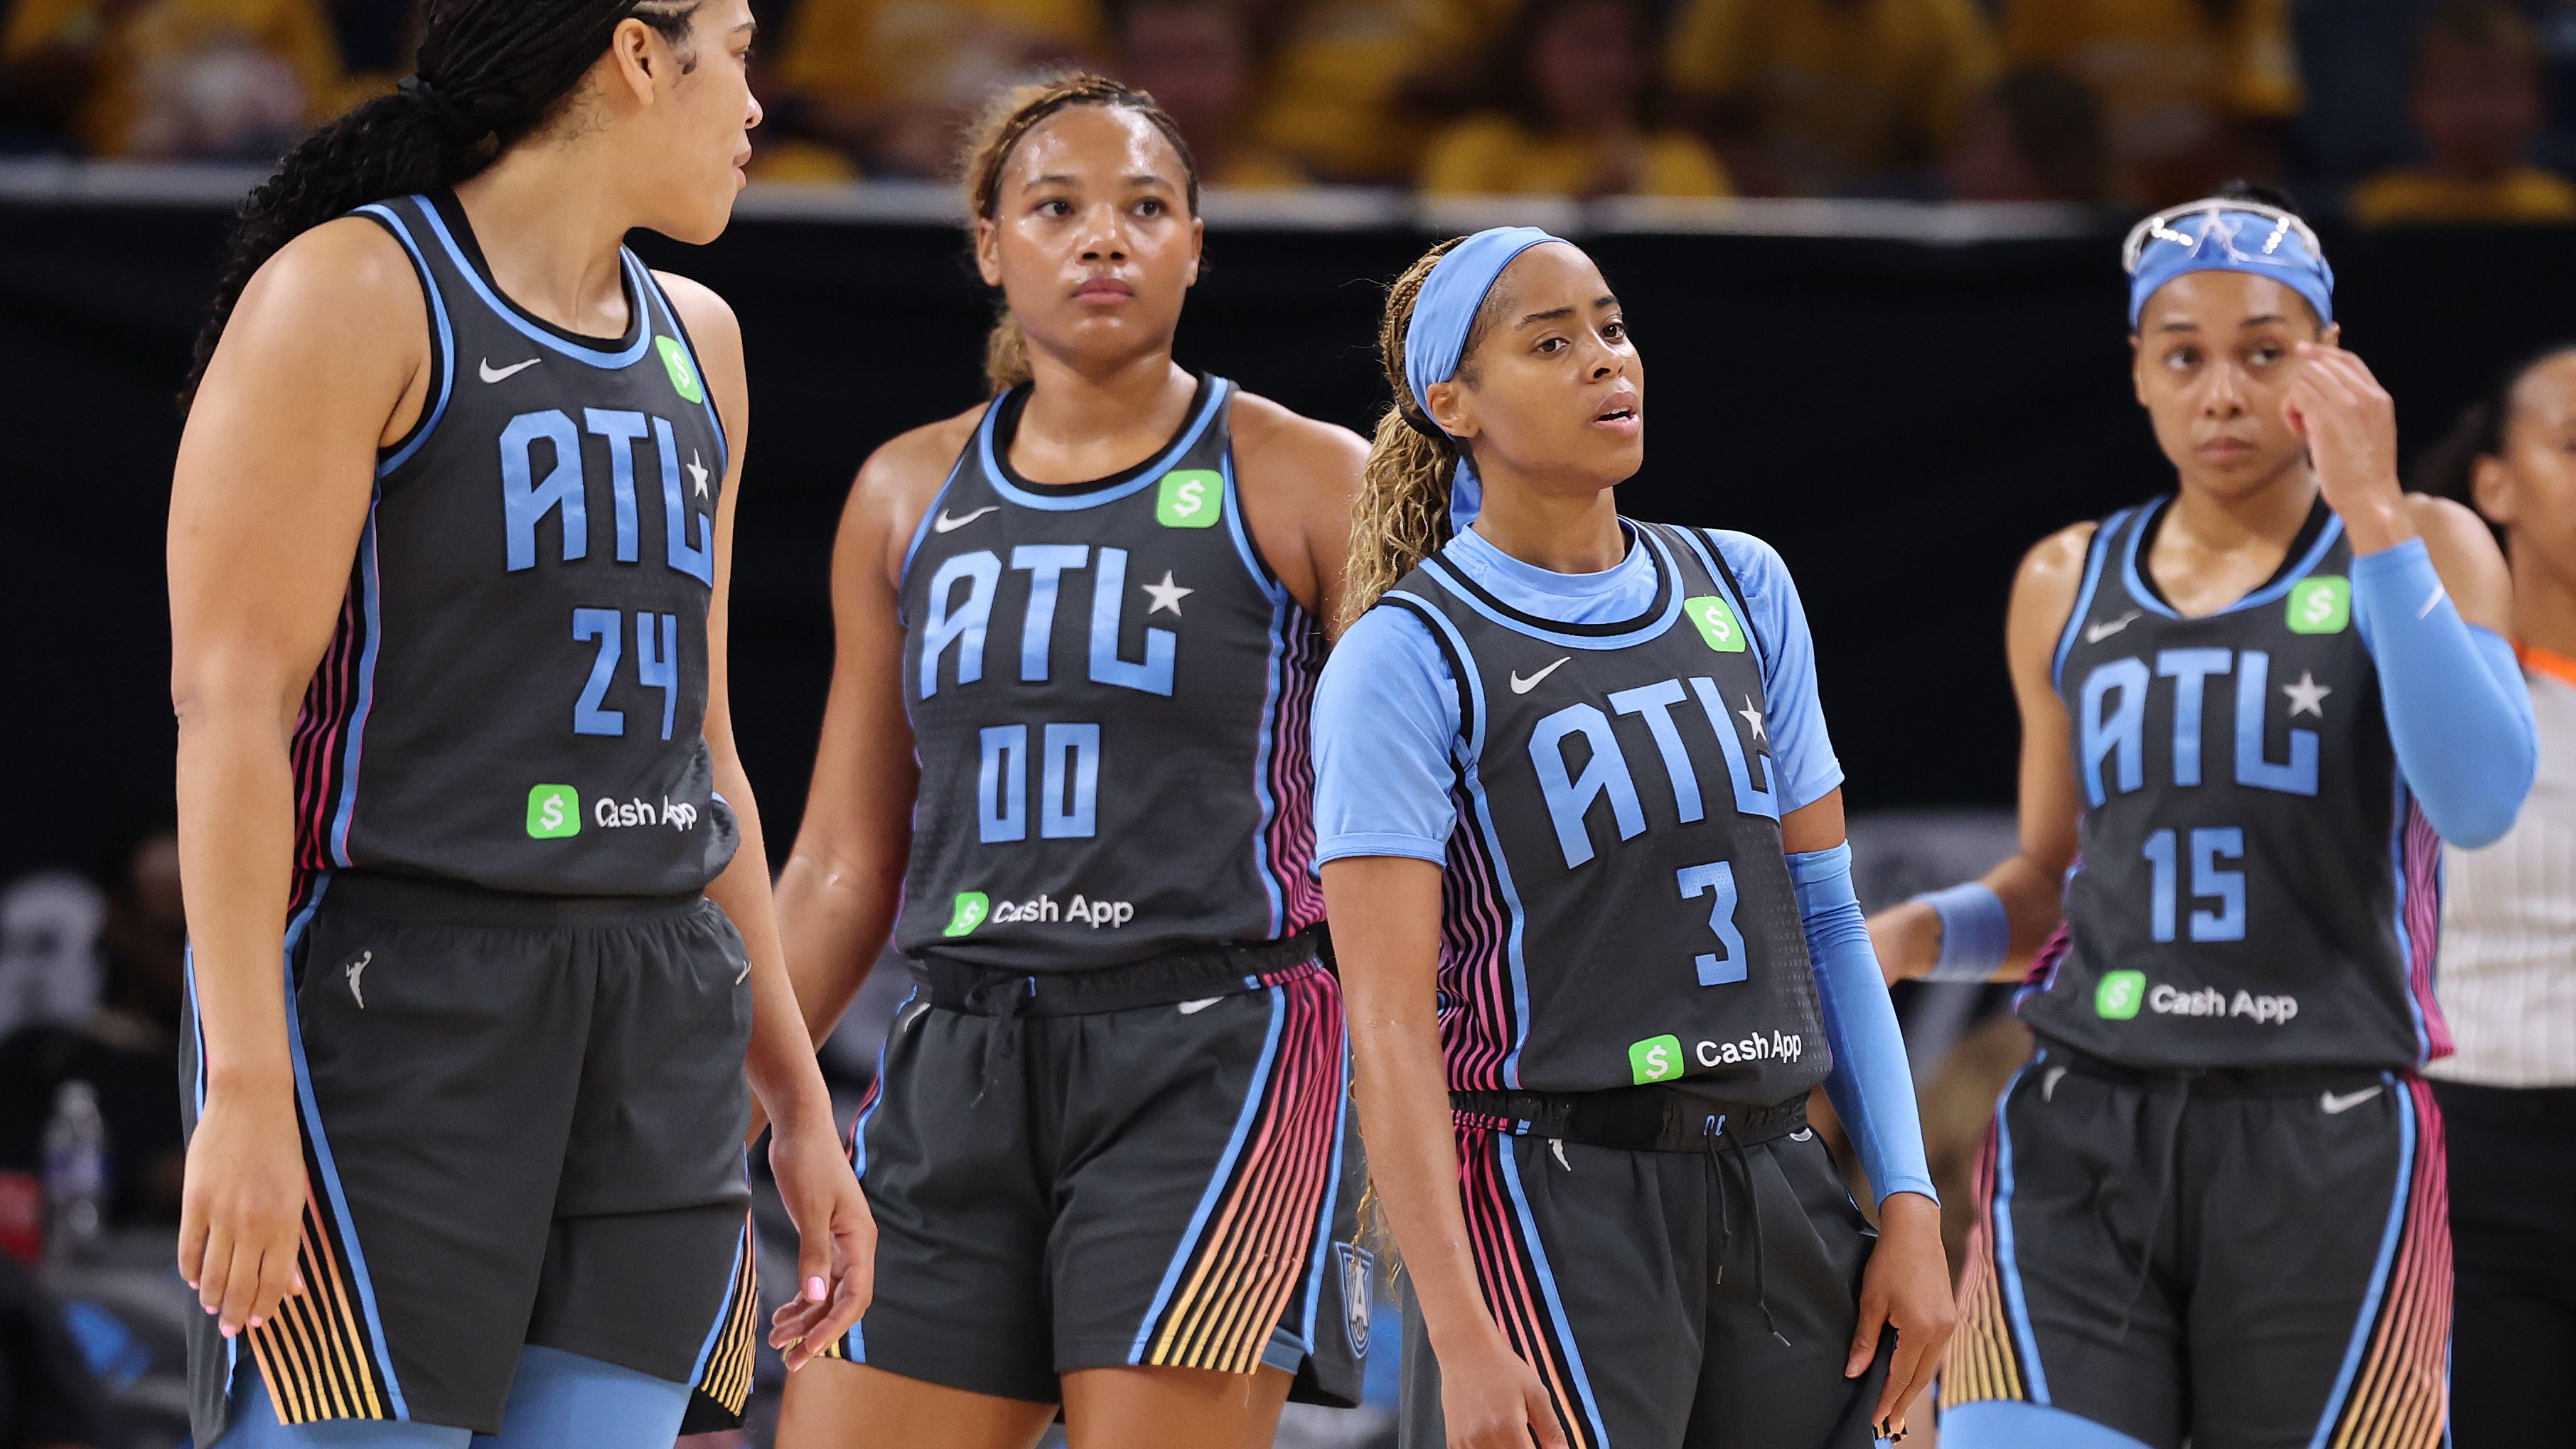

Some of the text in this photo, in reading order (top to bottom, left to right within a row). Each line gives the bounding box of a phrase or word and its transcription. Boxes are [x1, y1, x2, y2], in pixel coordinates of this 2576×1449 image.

[499, 407, 713, 588] ATL
[573, 608, 679, 740] 24
[920, 544, 1177, 700] ATL
[979, 722, 1101, 844] 00
[1528, 677, 1781, 871] ATL
[2080, 647, 2319, 809] ATL
[992, 894, 1059, 924] Cash
[1065, 894, 1134, 929] App
[1677, 861, 1748, 986] 3
[2142, 826, 2246, 943] 15
[1696, 1032, 1769, 1067] Cash
[1771, 1030, 1803, 1064] App
[2148, 984, 2226, 1018] Cash
[2229, 989, 2299, 1025] App
